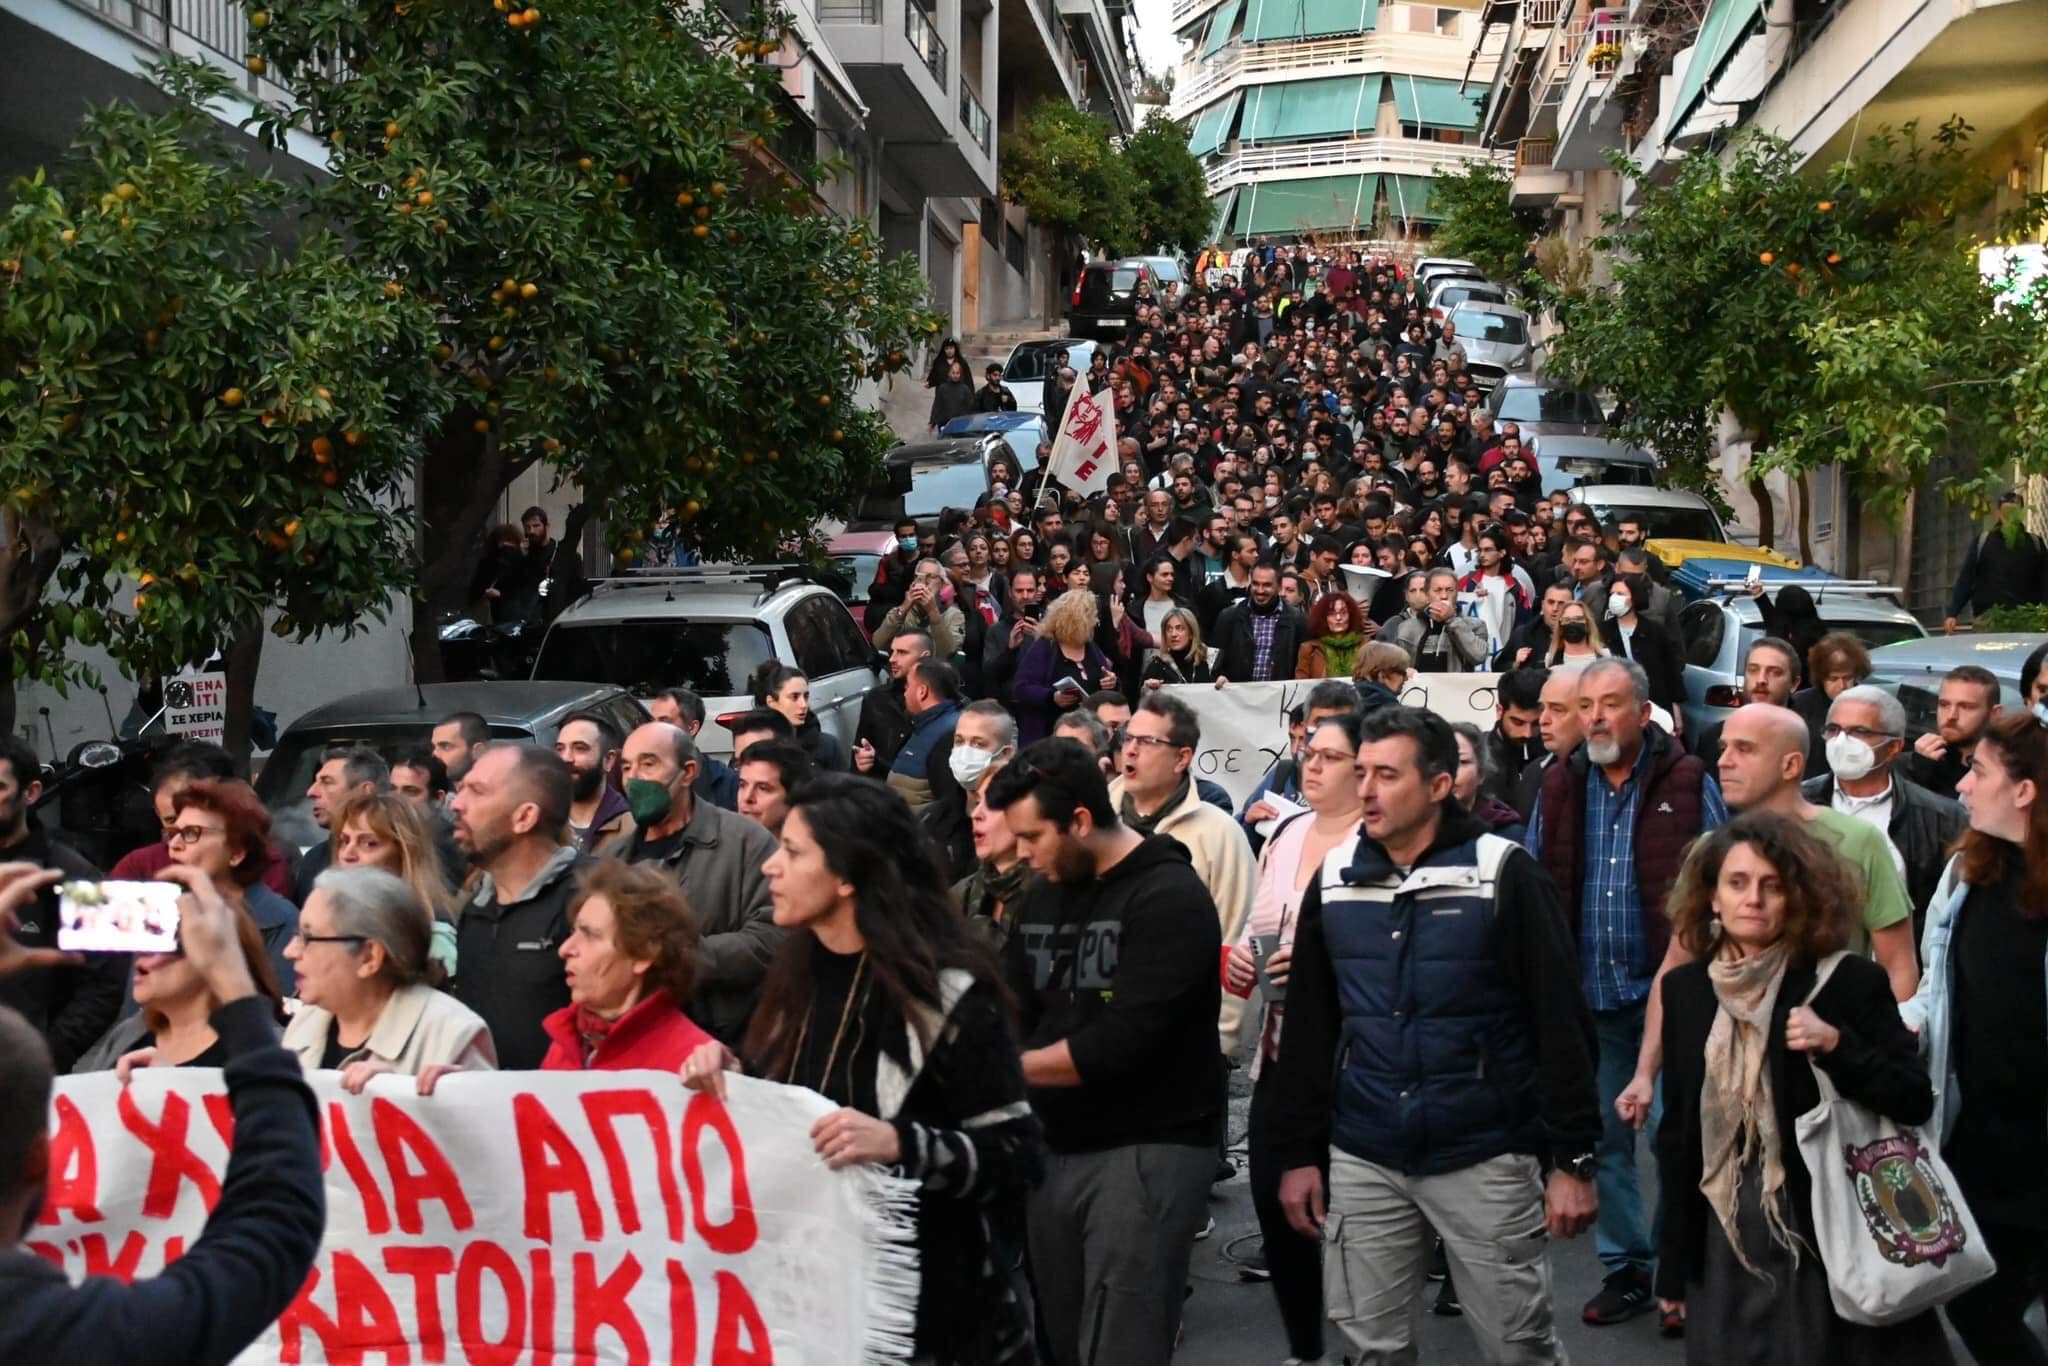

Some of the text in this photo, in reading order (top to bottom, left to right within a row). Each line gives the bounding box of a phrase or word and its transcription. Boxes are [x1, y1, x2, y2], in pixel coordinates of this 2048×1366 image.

[191, 680, 223, 691] ΕΝΑ
[171, 711, 223, 725] ΣΕ ΧΕΡΙΑ
[1199, 749, 1241, 775] σε
[118, 1085, 474, 1235] ΧΙΑ
[513, 1089, 758, 1255] ΑΠΟ
